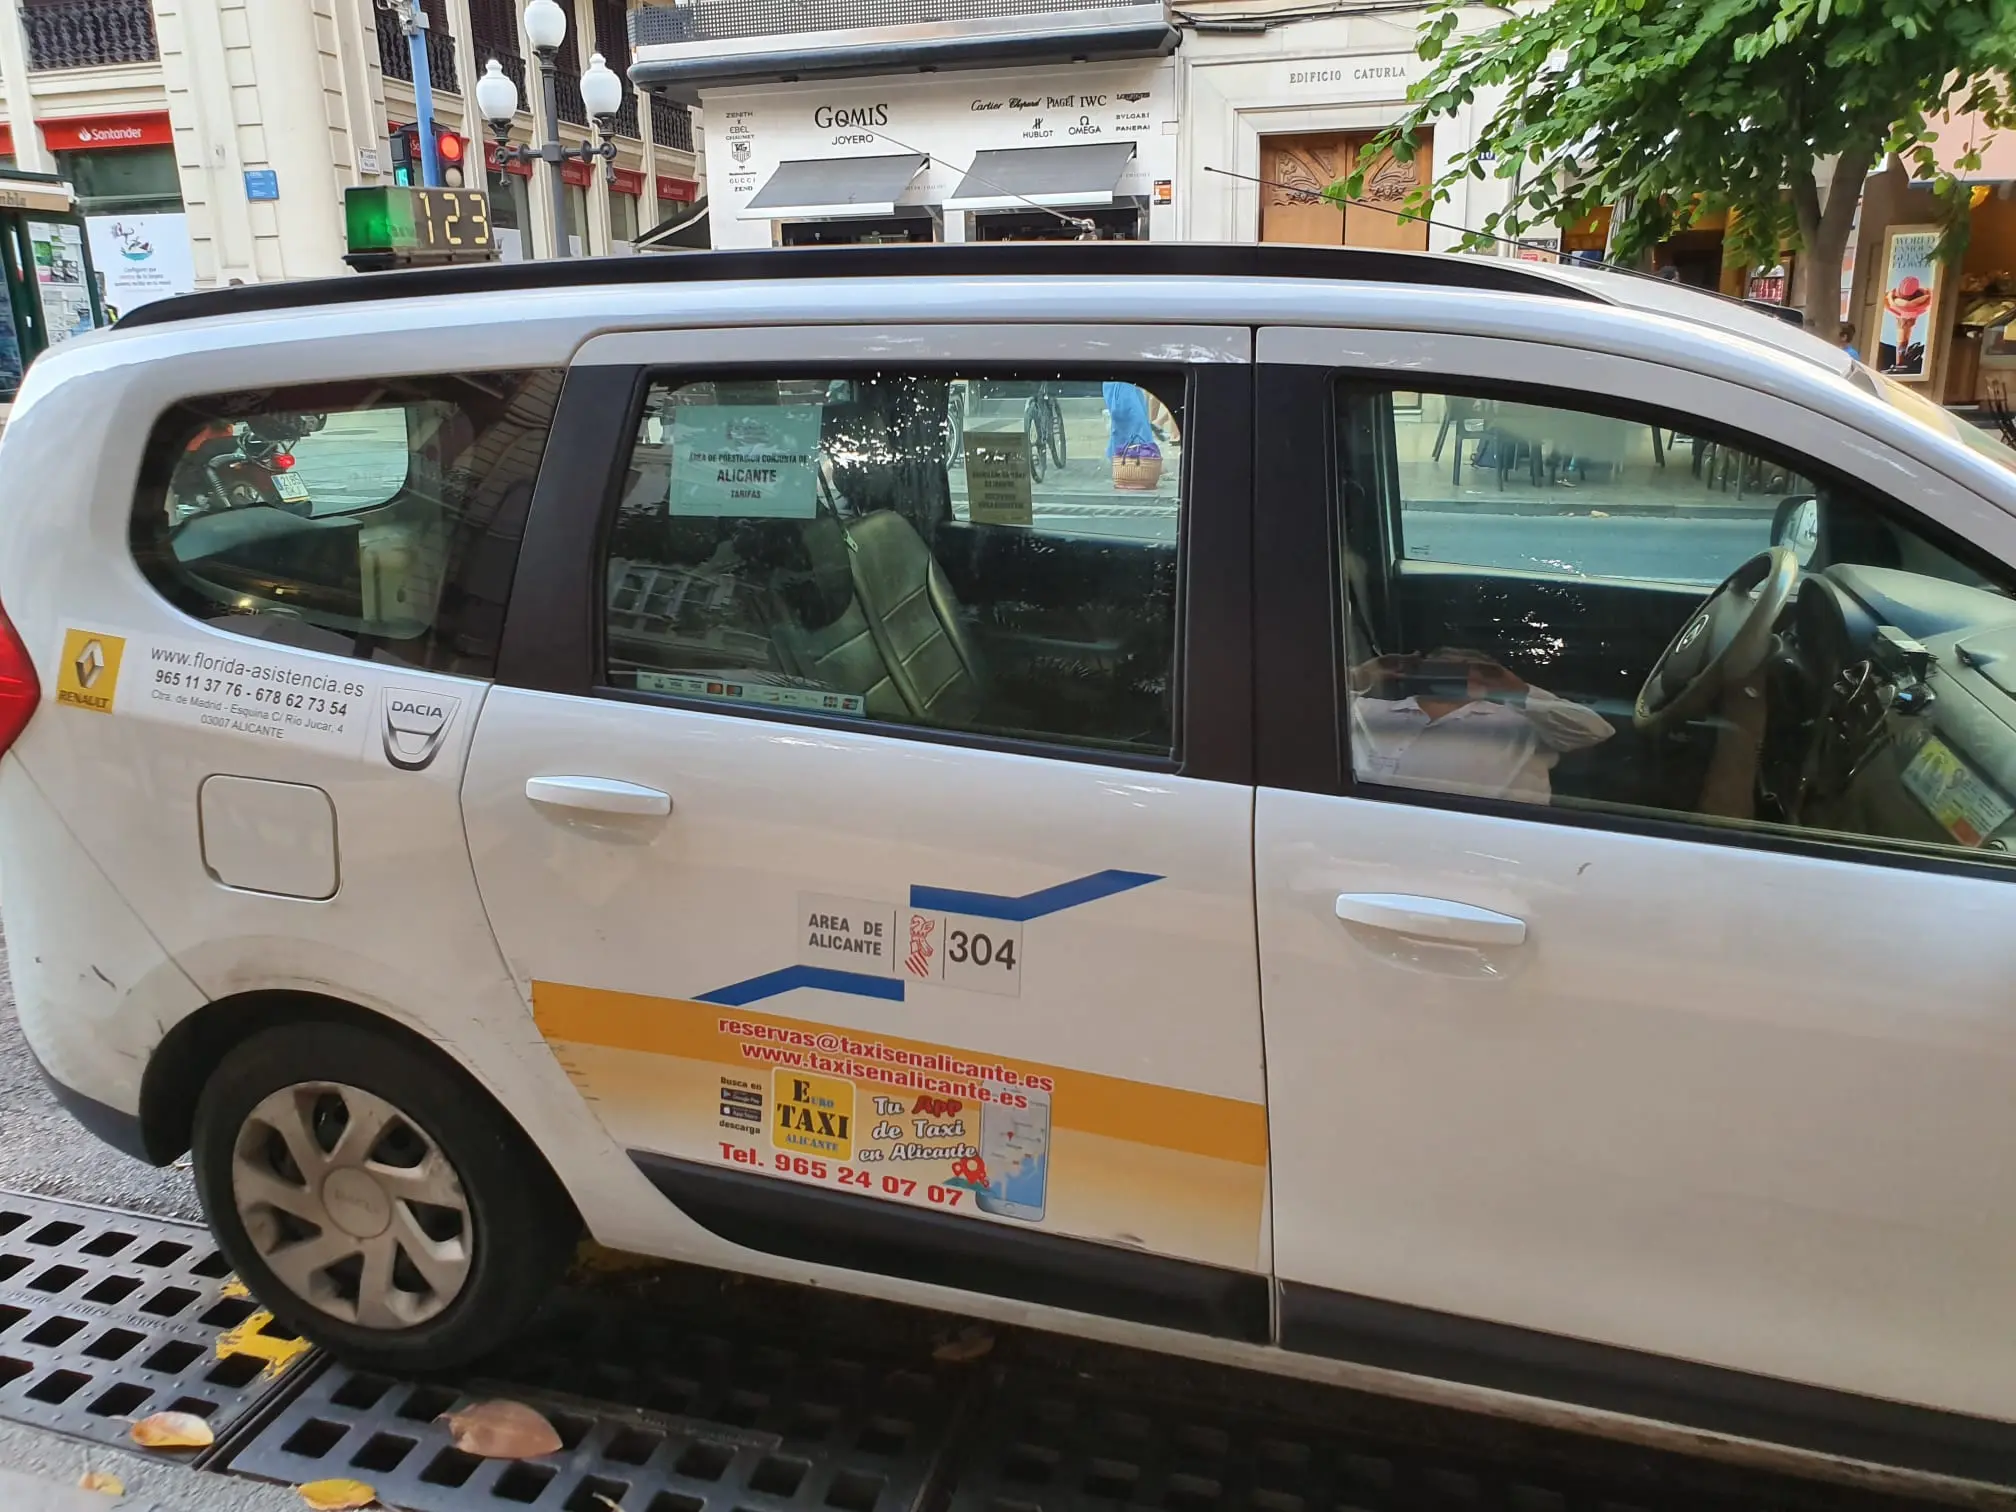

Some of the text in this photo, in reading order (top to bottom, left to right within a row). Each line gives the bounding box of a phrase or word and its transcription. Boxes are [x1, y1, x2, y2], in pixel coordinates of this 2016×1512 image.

[1290, 67, 1406, 84] EDIFICIO CATURLA
[971, 99, 1003, 112] Cartier
[1080, 95, 1107, 108] IWC
[725, 111, 753, 119] ZENITH
[1116, 112, 1150, 120] BVLGARI
[91, 127, 142, 141] Santander
[729, 126, 749, 134] EBEL
[1022, 130, 1054, 139] HUBLOT
[1068, 126, 1101, 136] OMEGA
[831, 134, 874, 146] JOYERO
[717, 469, 777, 483] ALICANTE
[731, 490, 762, 499] TARIFAS
[151, 646, 365, 697] www.florida-asistencia.es
[58, 690, 111, 708] RENAULT
[155, 669, 182, 686] 965
[185, 675, 200, 690] 11
[204, 678, 222, 693] 37
[225, 682, 243, 697] 76
[255, 687, 282, 705] 678
[286, 693, 304, 709] 62
[308, 697, 326, 713] 73
[329, 701, 348, 717] 54
[151, 689, 172, 701] Ctra.
[175, 694, 188, 705] de
[190, 696, 221, 711] Madrid
[231, 703, 269, 721] Esquina
[271, 711, 285, 723] C/
[337, 724, 344, 735] 4
[391, 700, 443, 719] DACIA
[200, 713, 285, 739] 03007 ALICANTE
[808, 913, 883, 937] AREA DE
[808, 933, 882, 956] ALICANTE
[949, 930, 1016, 971] 304
[718, 1017, 1054, 1092] reservas@taxisenalicante.es
[720, 1076, 762, 1091] Busca en
[741, 1041, 1029, 1109] www.taxisenalicante.es
[872, 1095, 963, 1118] Tu App
[719, 1120, 761, 1135] descarga
[776, 1103, 849, 1139] TAXI
[872, 1118, 966, 1140] de Taxi
[785, 1133, 839, 1152] ALICANTE
[859, 1147, 884, 1162] en
[889, 1142, 979, 1161] Alicante
[719, 1142, 963, 1206] Tel. 965 24 07 07
